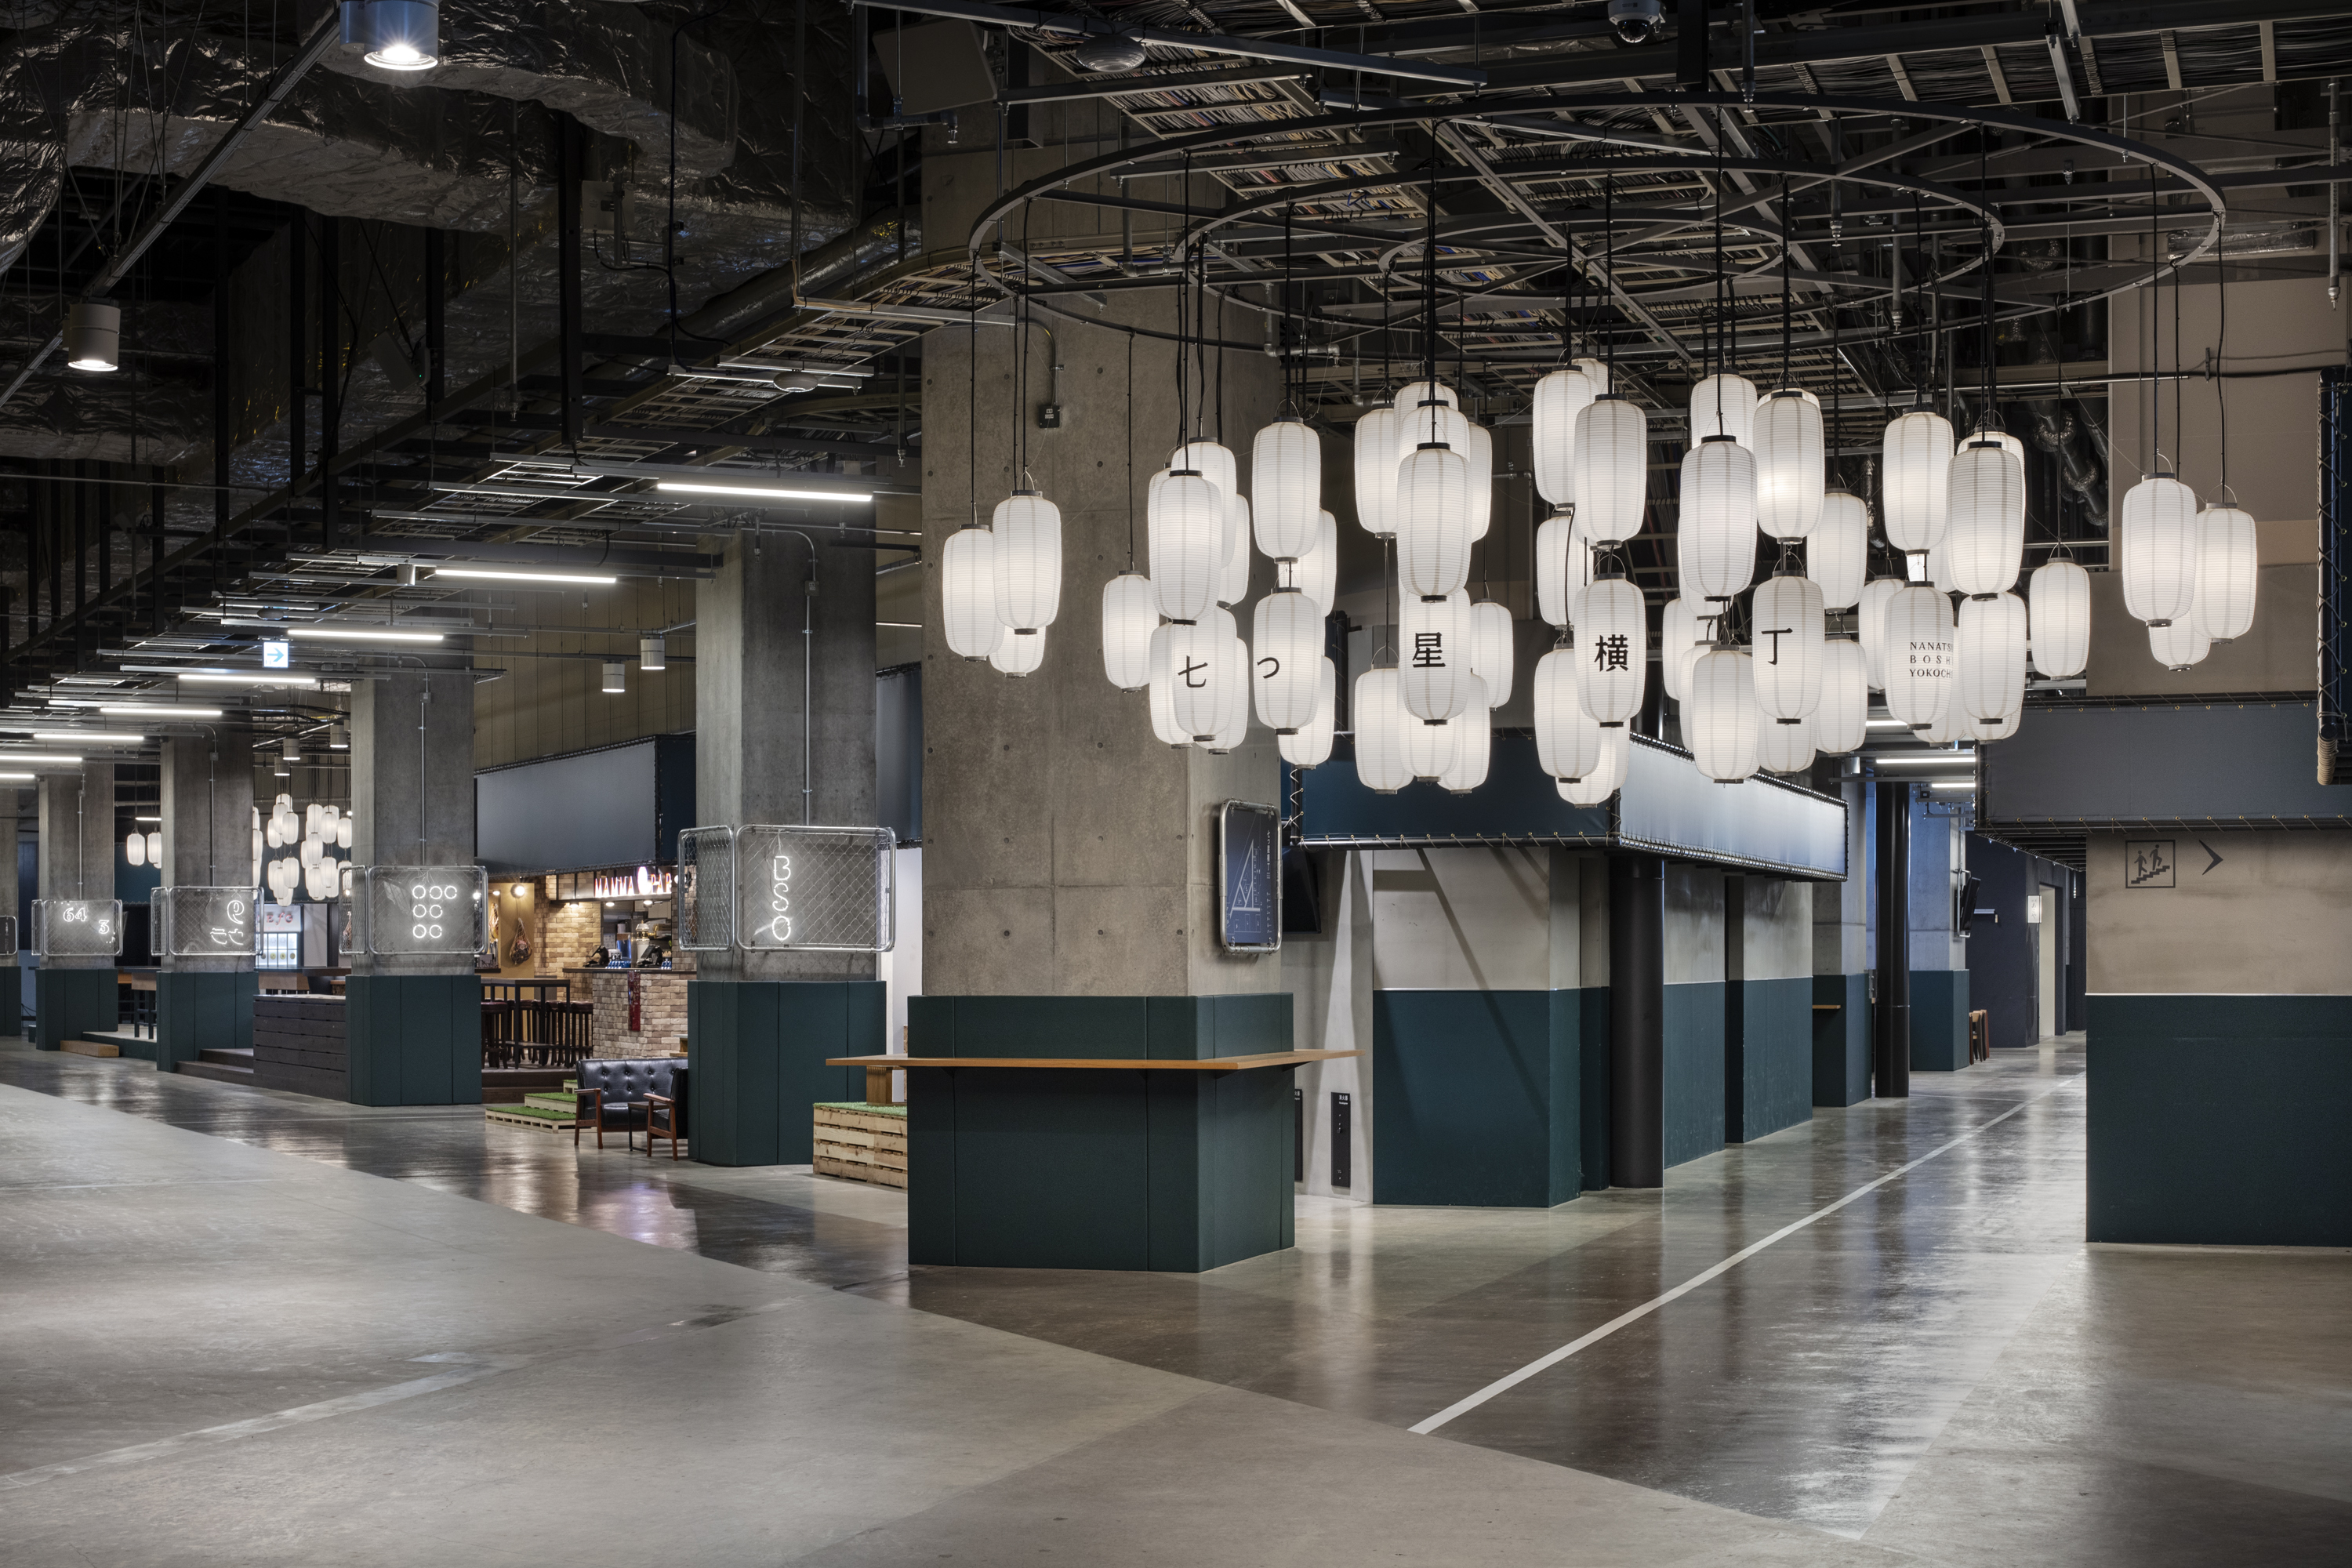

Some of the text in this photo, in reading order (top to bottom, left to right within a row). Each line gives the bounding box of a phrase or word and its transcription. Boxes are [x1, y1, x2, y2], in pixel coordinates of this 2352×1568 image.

[1413, 633, 1446, 667] 星
[1595, 634, 1628, 672] 横
[1762, 628, 1793, 665] 丁
[1178, 655, 1208, 688] 七
[1257, 657, 1279, 679] つ
[594, 875, 635, 898] MAMMA
[63, 907, 88, 922] 64
[98, 919, 110, 935] 3
